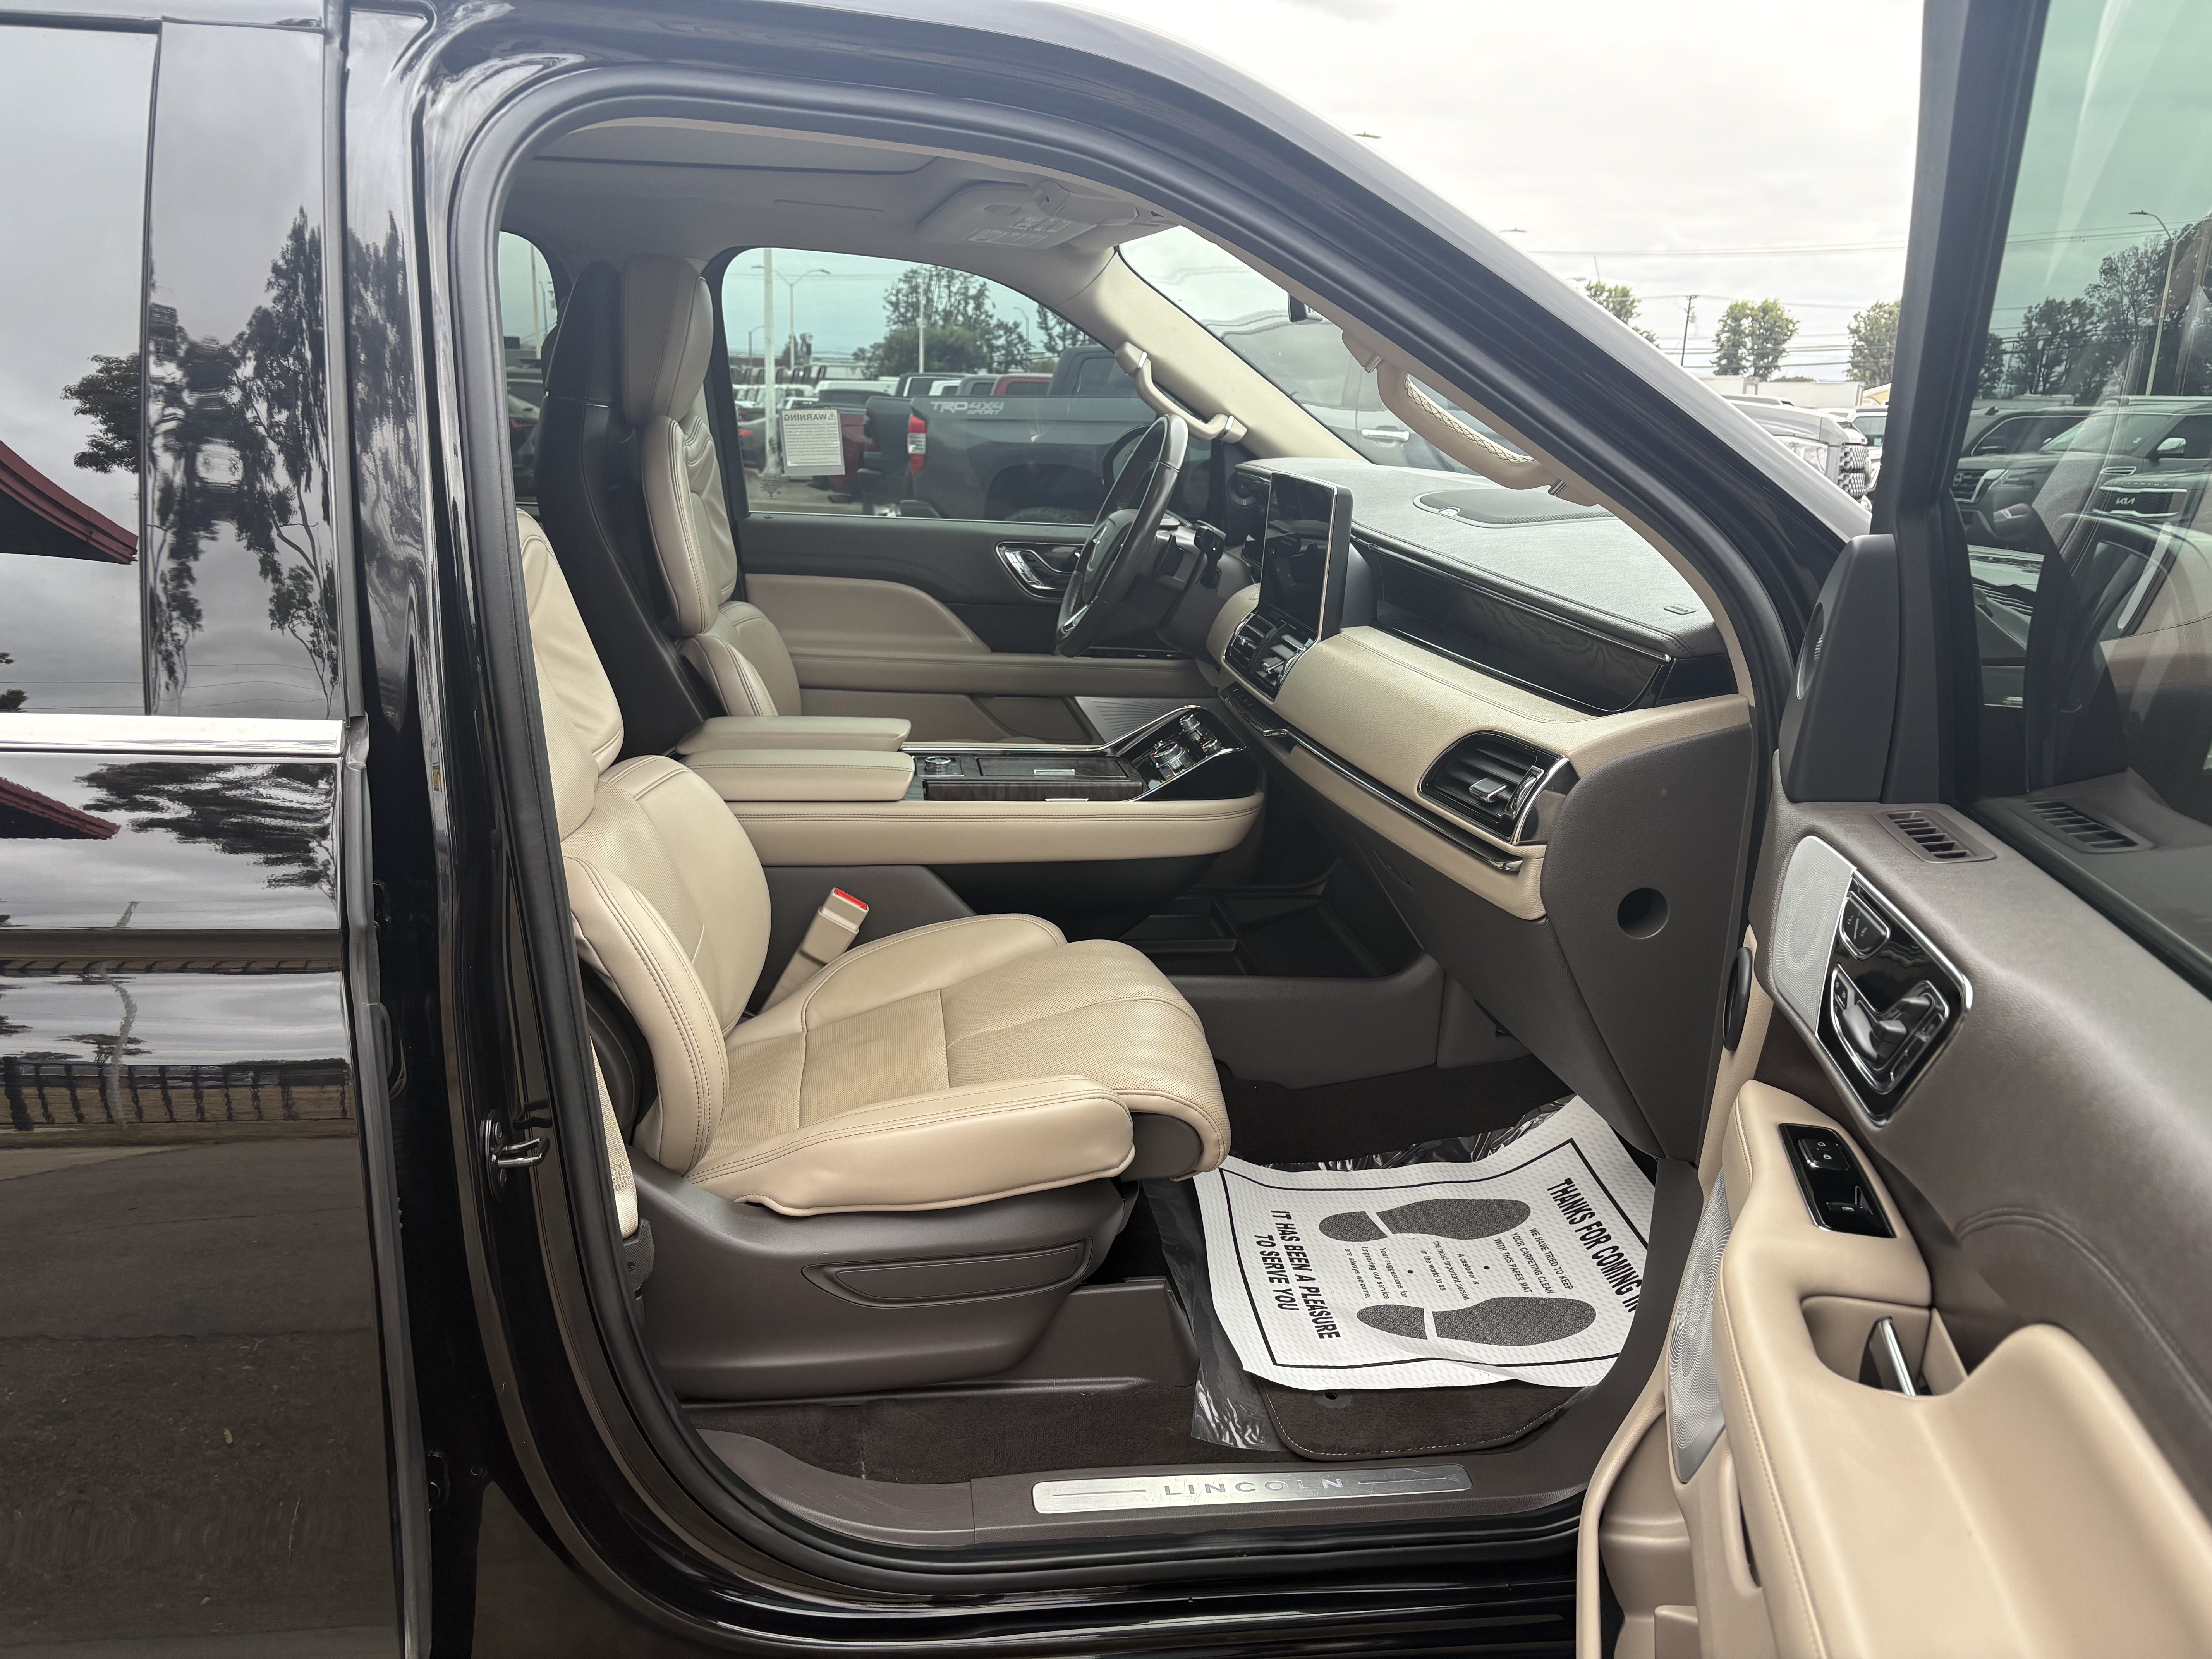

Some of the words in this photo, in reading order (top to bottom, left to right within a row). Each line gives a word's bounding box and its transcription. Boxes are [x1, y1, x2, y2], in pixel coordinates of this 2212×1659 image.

[2116, 497, 2136, 505] KIA
[1271, 1210, 1292, 1220] IT
[1547, 1178, 1595, 1224] THANKS
[1254, 1234, 1276, 1247] TO
[1275, 1223, 1300, 1242] HAS
[1575, 1221, 1612, 1250] FOR
[1259, 1250, 1290, 1284] SERVE
[1284, 1245, 1312, 1271] BEEN
[1361, 1247, 1377, 1271] improving
[1373, 1272, 1381, 1280] our
[1377, 1280, 1389, 1299] service
[1379, 1247, 1389, 1259] Your
[1385, 1259, 1403, 1289] suggestions
[1428, 1263, 1441, 1277] world
[1460, 1258, 1476, 1281] customer
[1494, 1238, 1507, 1251] WITH
[1502, 1252, 1514, 1263] THIS
[1508, 1264, 1525, 1281] PAPER
[1519, 1282, 1532, 1293] MAT
[1511, 1232, 1525, 1246] YOUR
[1520, 1247, 1542, 1276] CARPETING
[1538, 1276, 1554, 1293] CLEAN
[1529, 1228, 1540, 1237] WE
[1535, 1237, 1549, 1251] HAVE
[1544, 1250, 1559, 1266] TRIED
[1554, 1266, 1564, 1274] TO
[1559, 1275, 1573, 1289] KEEP
[1592, 1245, 1642, 1295] COMING
[1294, 1274, 1316, 1282] A
[1348, 1257, 1360, 1274] always
[1357, 1275, 1371, 1298] welcome.
[1437, 1249, 1448, 1260] most
[1444, 1261, 1460, 1283] important
[1454, 1283, 1470, 1300] person
[1272, 1288, 1300, 1310] YOU
[1298, 1286, 1341, 1339] PLEASURE
[1164, 1478, 1343, 1496] LINCOLN
